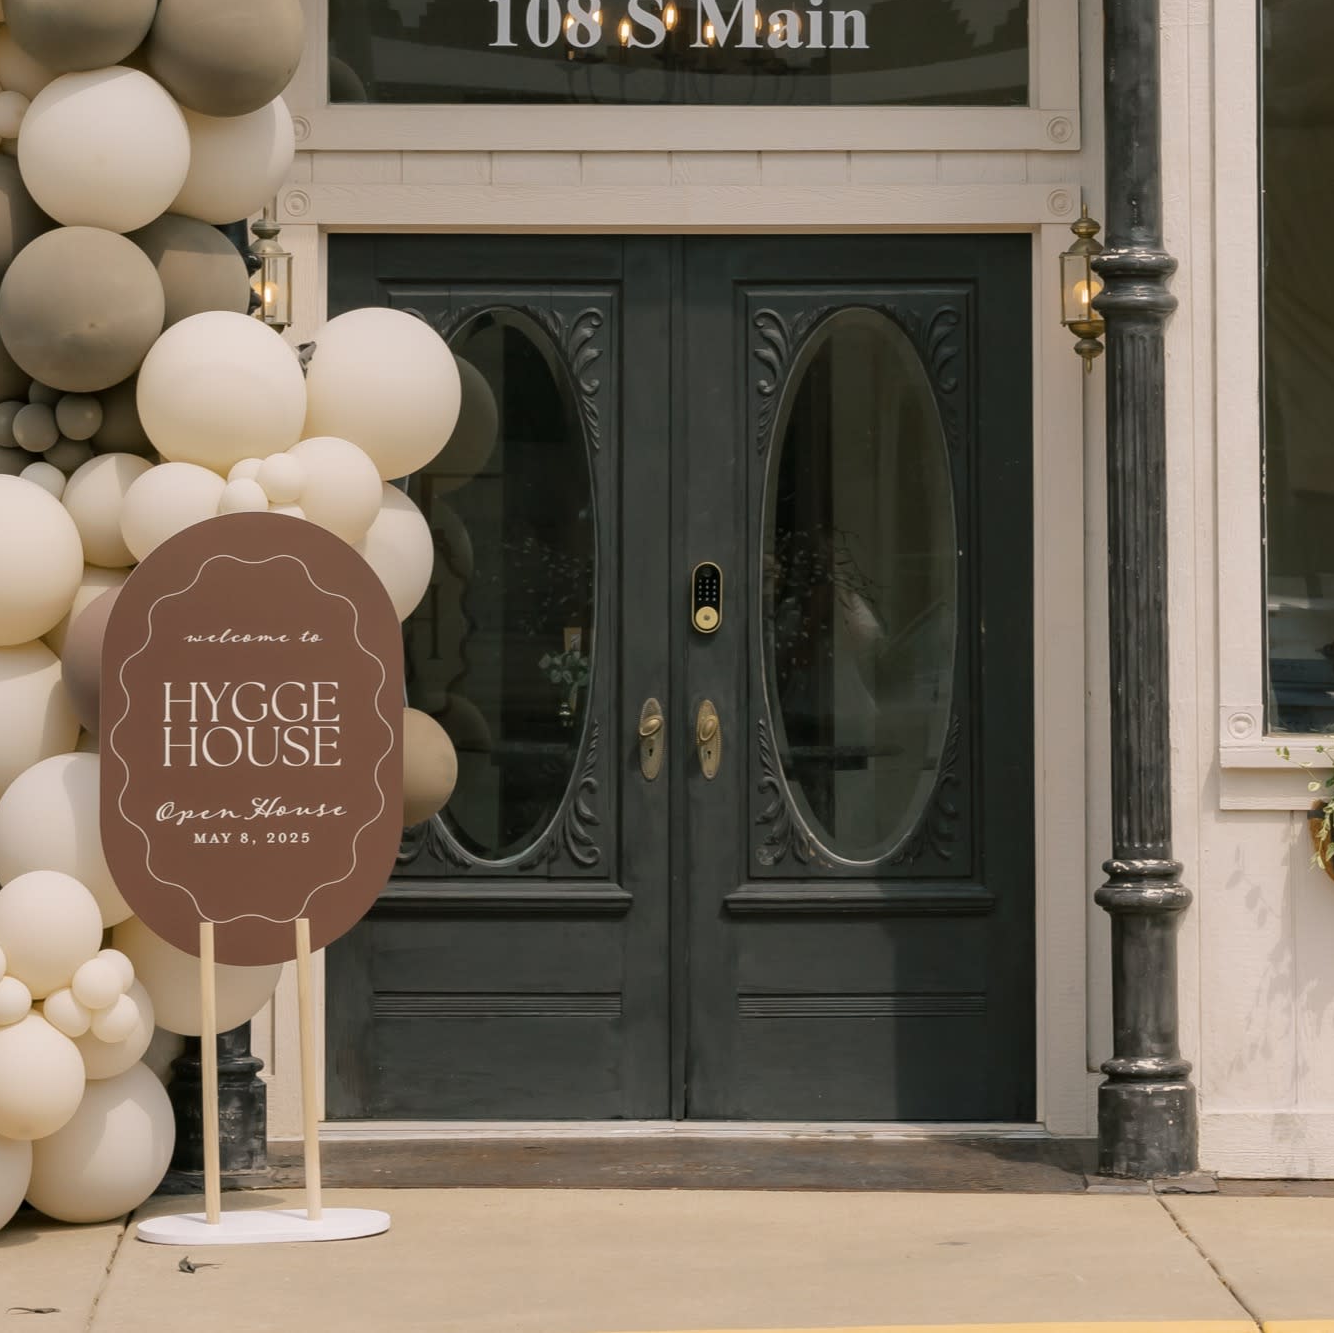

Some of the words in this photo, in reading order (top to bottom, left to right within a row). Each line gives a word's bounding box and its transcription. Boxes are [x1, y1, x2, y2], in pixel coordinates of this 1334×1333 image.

[183, 628, 291, 644] welcome
[298, 629, 323, 644] to
[163, 681, 340, 723] HYGGE
[162, 725, 342, 767] HOUSE
[155, 800, 240, 826] Open
[244, 796, 348, 822] House
[193, 832, 233, 844] MAY
[239, 832, 256, 846] 8,
[266, 832, 310, 844] 2025
